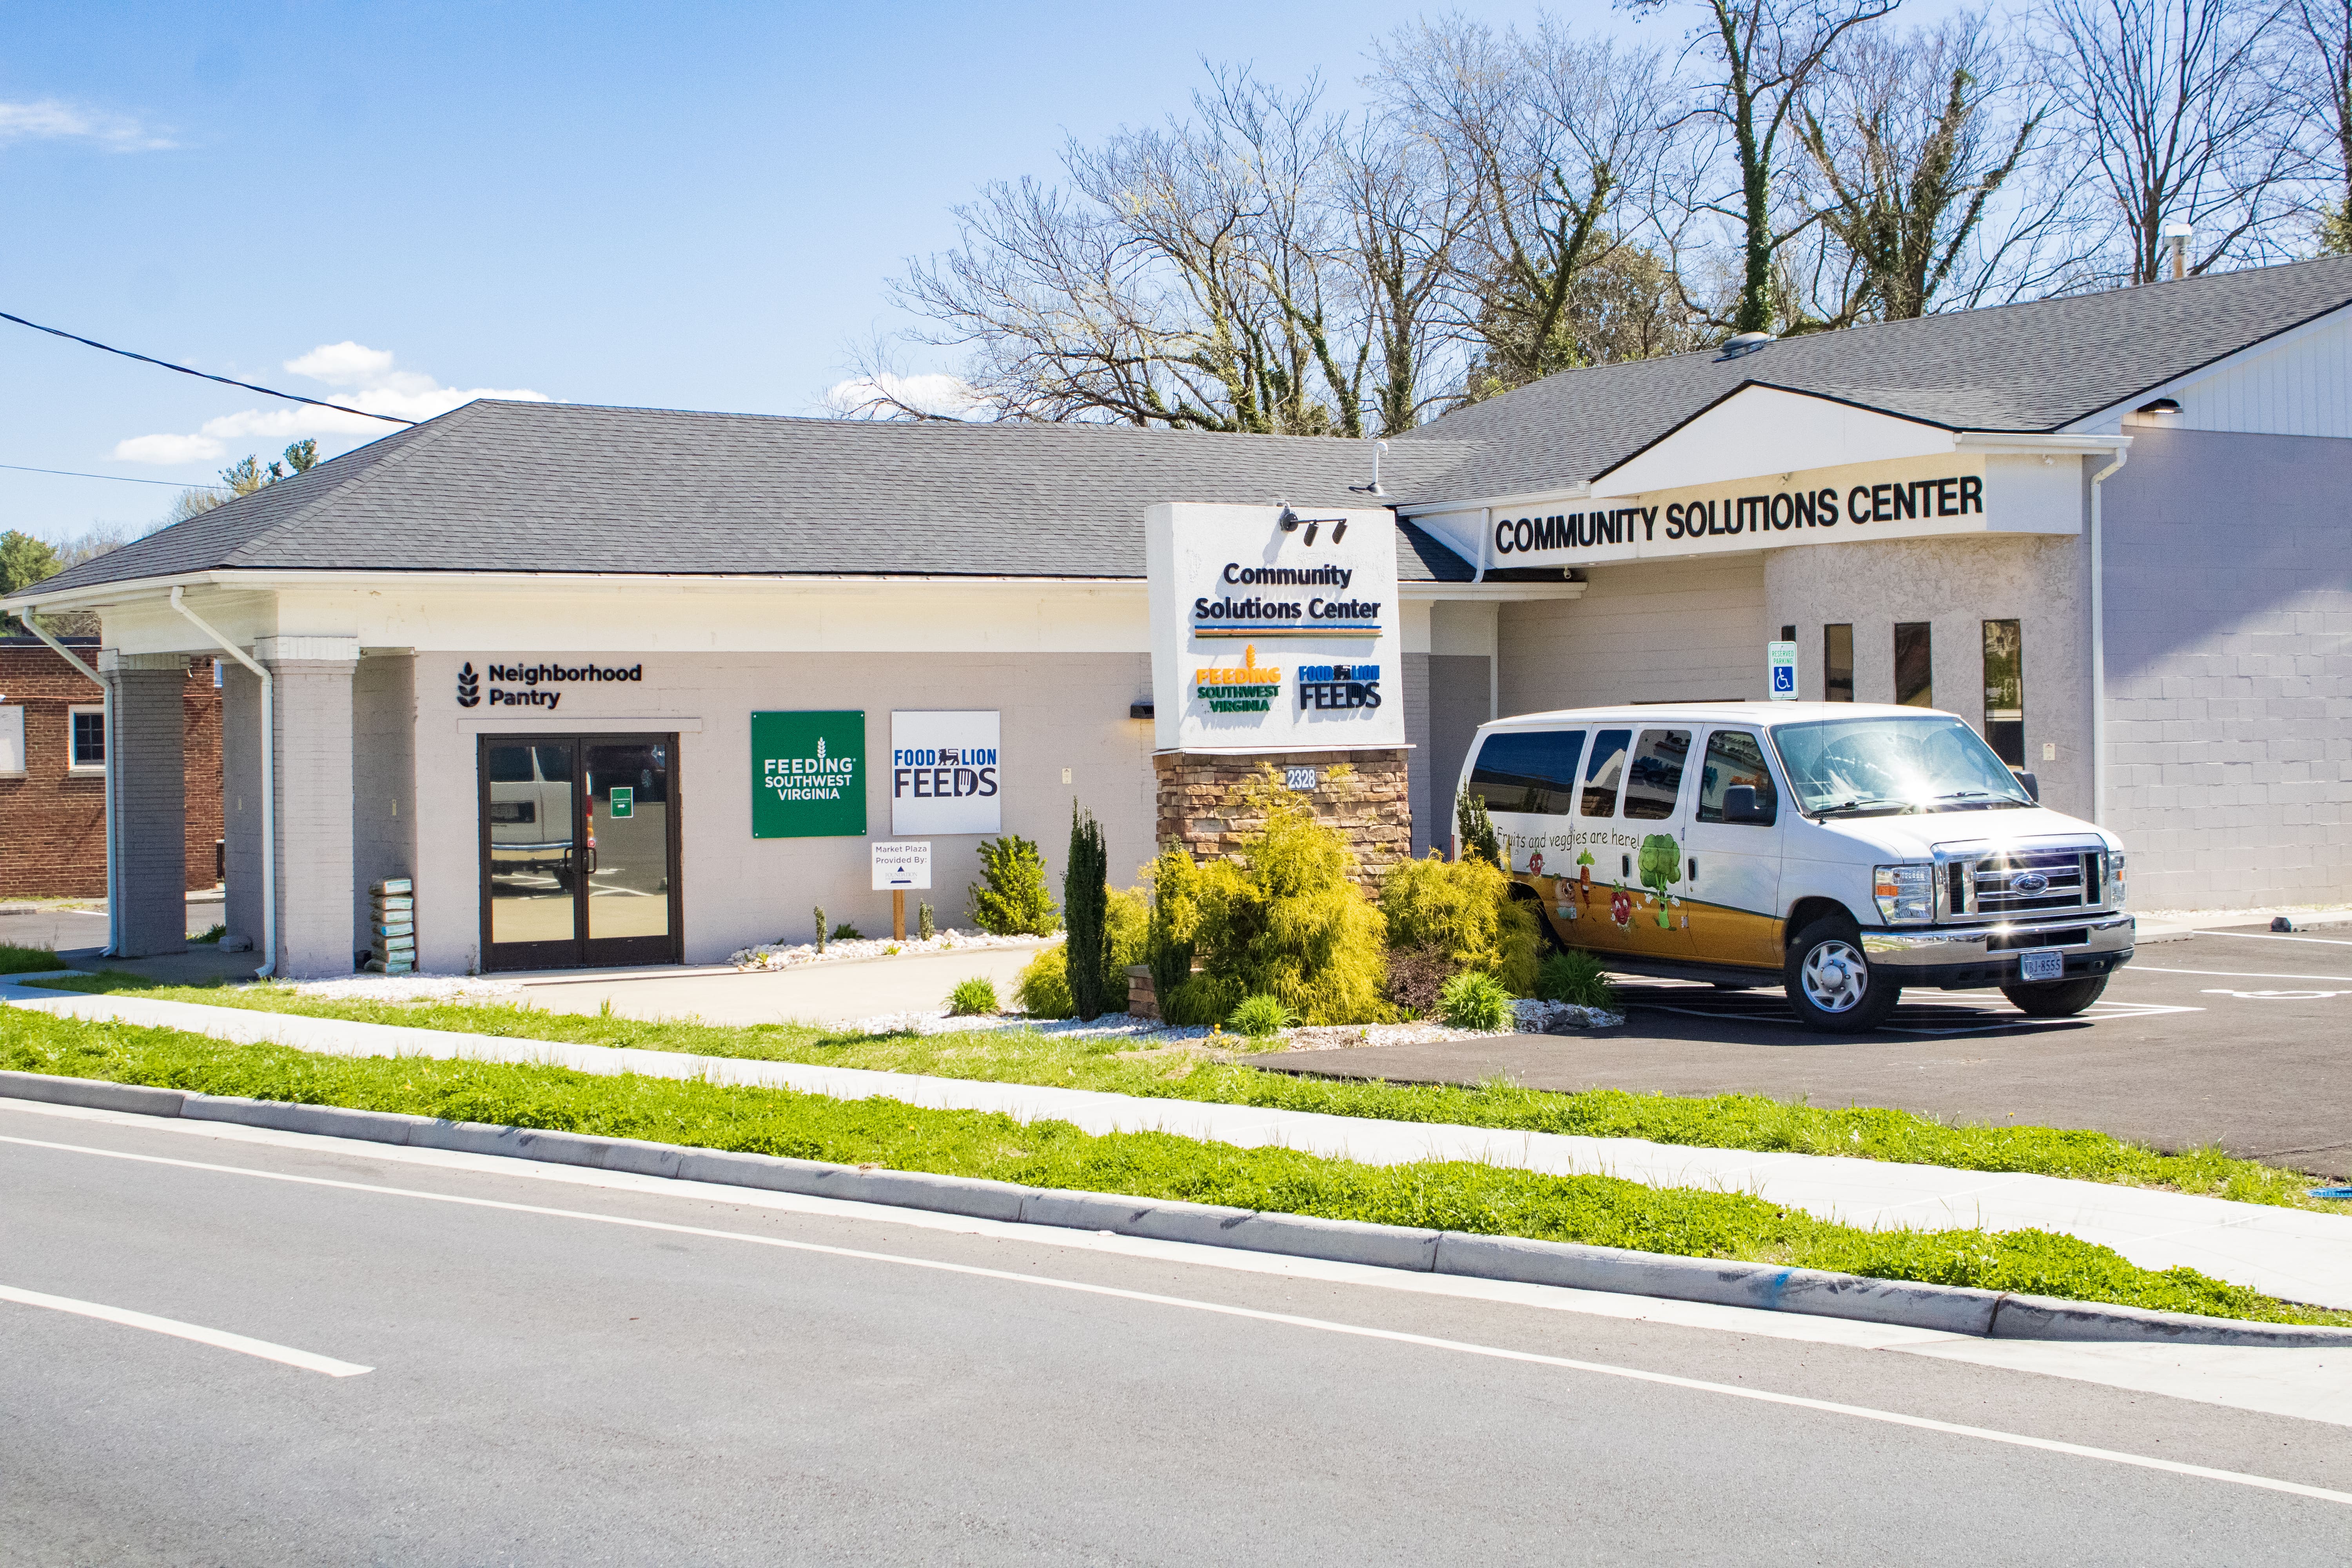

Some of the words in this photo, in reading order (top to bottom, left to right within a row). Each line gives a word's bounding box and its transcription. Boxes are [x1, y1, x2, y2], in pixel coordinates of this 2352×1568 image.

[1495, 506, 1659, 554] COMMUNITY
[1666, 488, 1839, 539] SOLUTIONS
[1847, 475, 1983, 524] CENTER
[1223, 563, 1352, 589] Community
[1195, 596, 1302, 619] Solutions
[1308, 598, 1381, 619] Center
[489, 663, 642, 685] Neighborhood
[1197, 667, 1281, 684] FEEDING
[1298, 665, 1333, 681] FOOD
[1352, 665, 1380, 681] LION
[489, 689, 561, 710] Pantry
[1197, 685, 1280, 699] SOUTHWEST
[1300, 682, 1382, 710] FEEDS
[1209, 699, 1270, 713] VIRGINIA
[765, 757, 853, 774] FEEDING
[894, 749, 935, 766] FOOD
[962, 748, 996, 766] LION
[765, 775, 852, 788] SOUTHWEST
[895, 767, 998, 798] FEEDS
[1288, 769, 1316, 789] 2328
[778, 788, 840, 800] VIRGINIA
[1497, 826, 1525, 848] Fruits
[1529, 831, 1546, 848] and
[1549, 829, 1587, 851] veggies
[1590, 832, 1608, 844] are
[1612, 827, 1639, 850] here!
